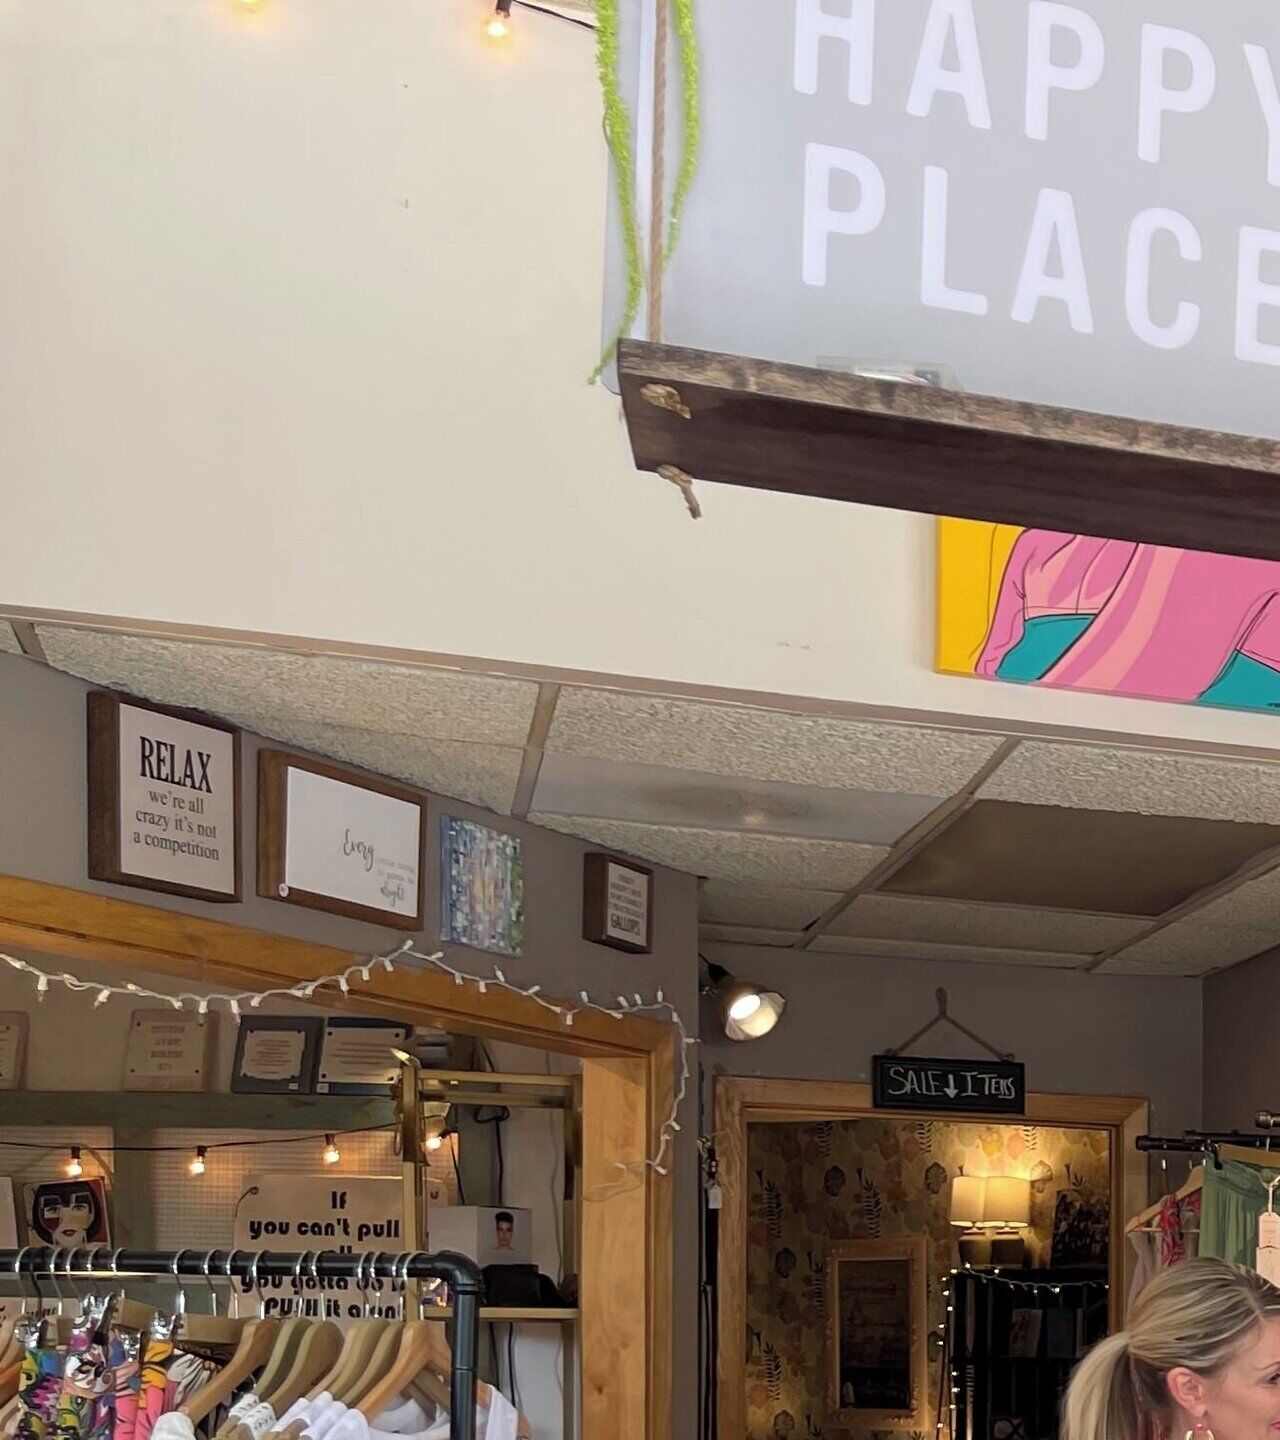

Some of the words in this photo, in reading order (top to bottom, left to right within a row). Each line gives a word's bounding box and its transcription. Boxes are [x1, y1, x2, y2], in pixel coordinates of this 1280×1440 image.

[140, 735, 213, 794] RELAX
[148, 790, 185, 809] we're
[188, 798, 204, 814] all
[135, 810, 169, 832] crazy
[174, 813, 194, 833] it's
[197, 824, 217, 839] not
[133, 832, 141, 843] a
[144, 834, 220, 860] competition
[887, 1067, 943, 1096] SALE
[959, 1072, 1015, 1099] ITEMS
[331, 1191, 348, 1209] If
[249, 1220, 290, 1240] you
[296, 1218, 350, 1236] can't
[357, 1219, 400, 1241] pull
[240, 1274, 283, 1293] you
[326, 1298, 341, 1318] it
